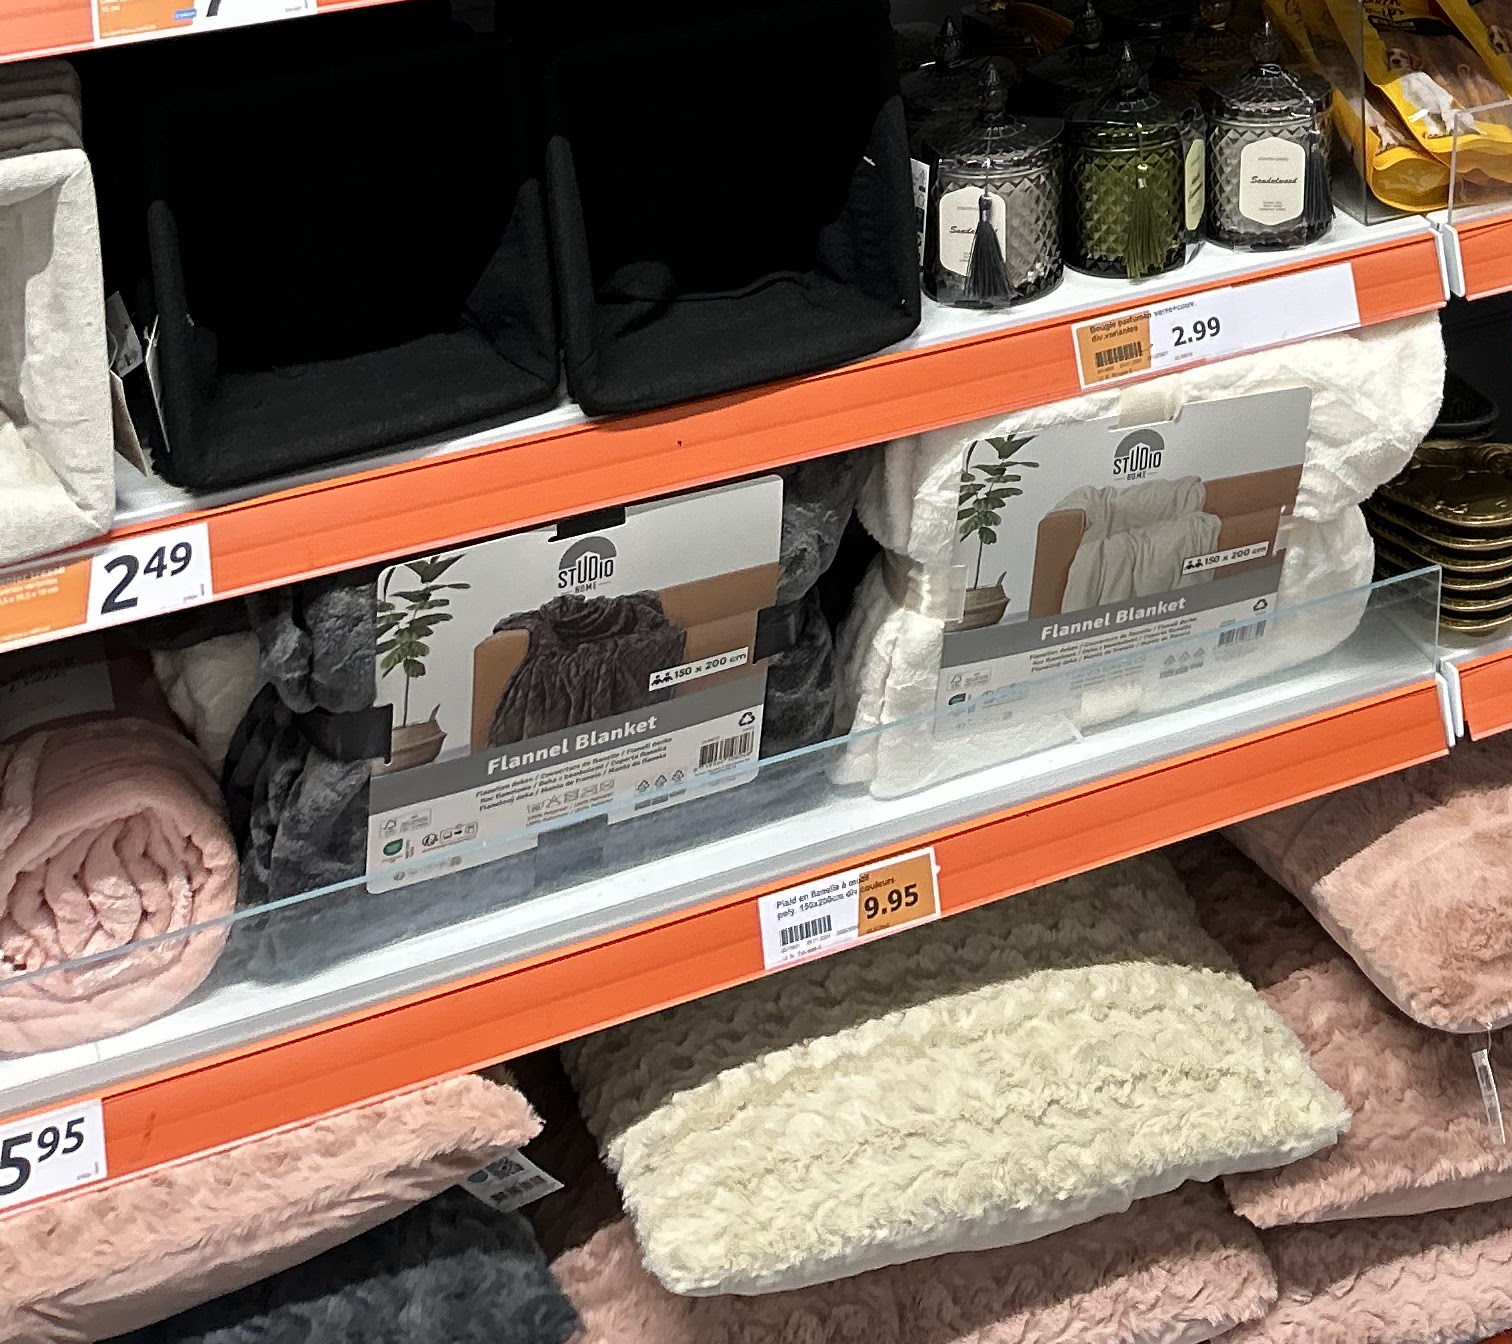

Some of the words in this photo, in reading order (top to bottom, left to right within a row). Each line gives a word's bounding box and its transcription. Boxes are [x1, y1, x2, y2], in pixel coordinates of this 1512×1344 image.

[1170, 315, 1222, 348] 2.99
[1112, 445, 1162, 475] STUDIO
[558, 555, 614, 589] STUDIO
[575, 580, 597, 593] HOME
[1041, 613, 1111, 641] Flannel
[1115, 596, 1186, 623] Blanket
[674, 666, 692, 680] 150
[704, 656, 727, 672] 200
[728, 652, 746, 664] cm
[487, 738, 570, 776] Flannel
[574, 715, 658, 752] Blanket
[863, 883, 919, 920] 9.95
